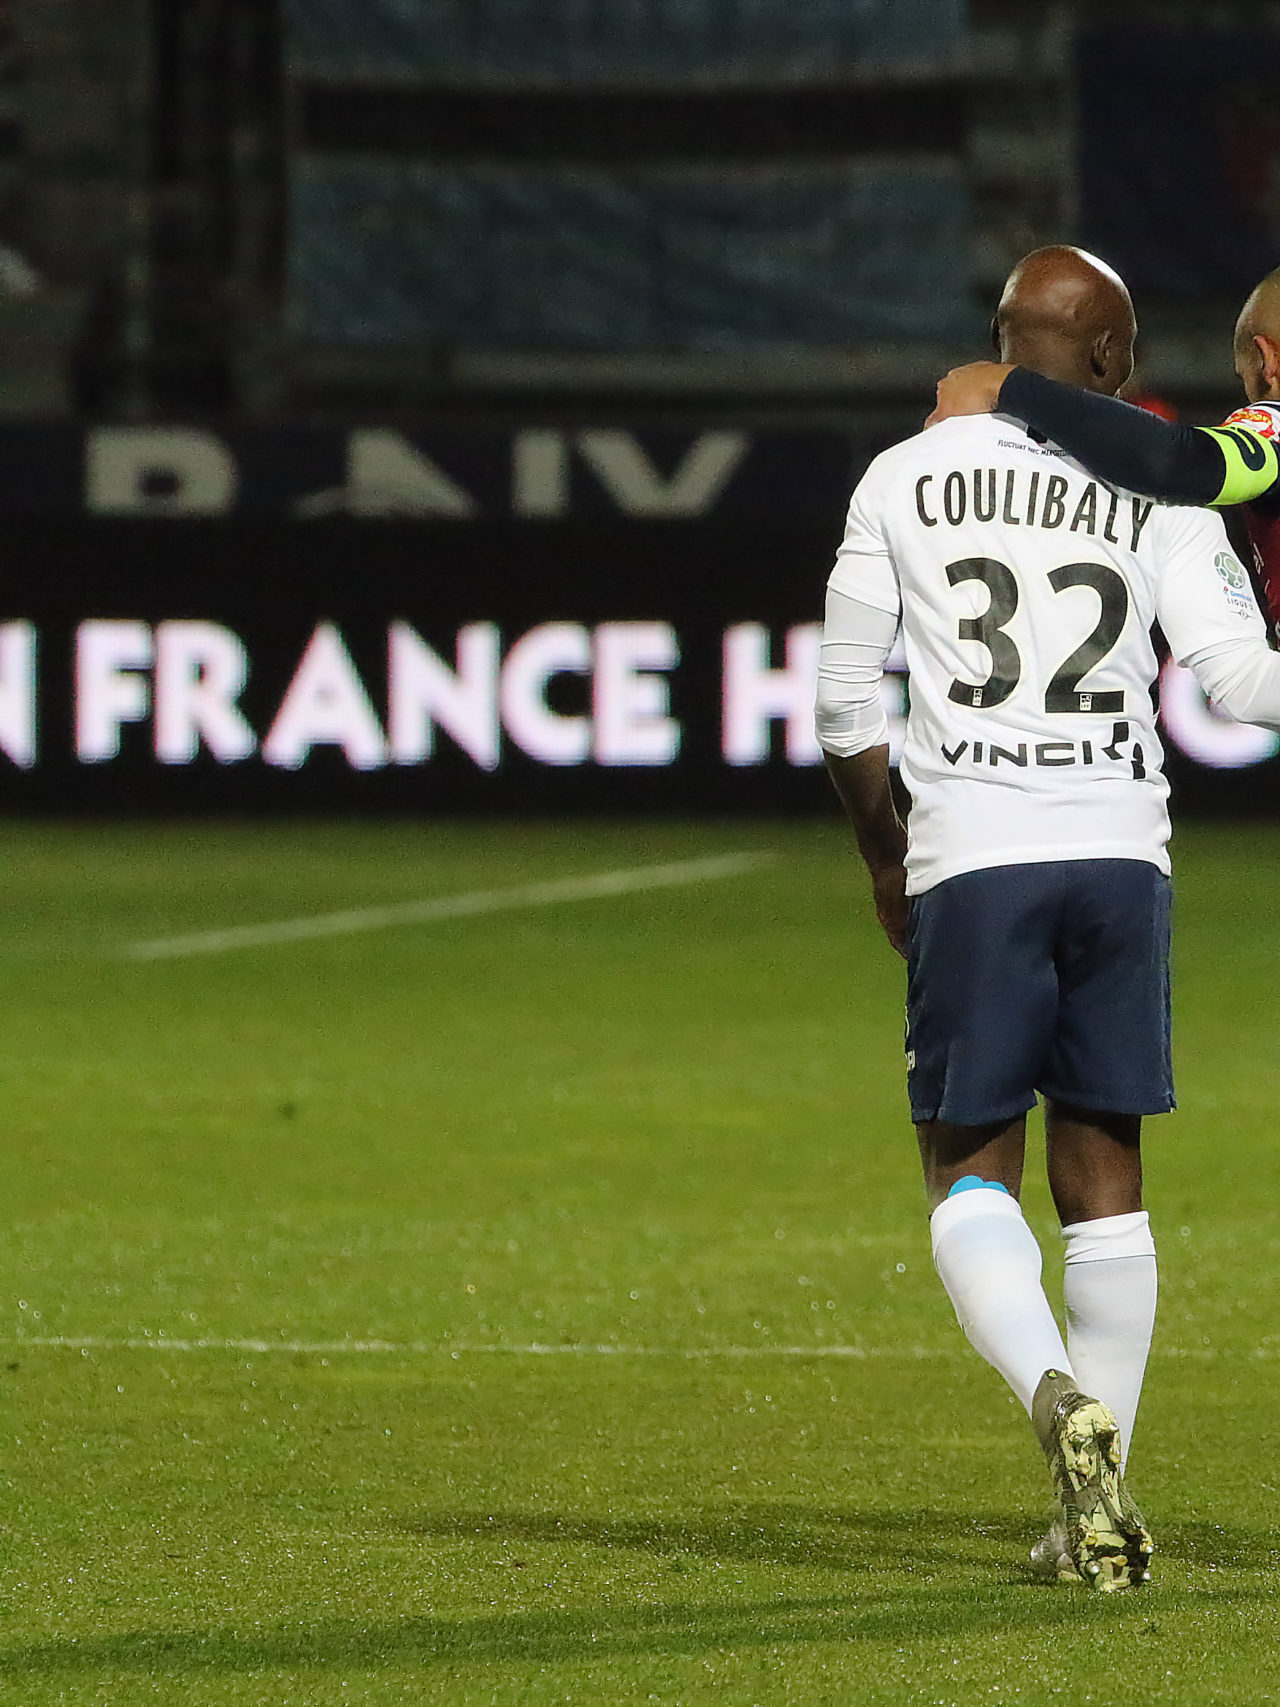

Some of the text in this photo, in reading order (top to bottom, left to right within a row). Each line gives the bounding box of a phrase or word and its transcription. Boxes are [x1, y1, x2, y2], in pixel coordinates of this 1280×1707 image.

[915, 468, 1154, 552] COULIBALY
[943, 556, 1129, 713] 32
[75, 619, 682, 771] FRANCE
[941, 741, 1092, 766] VINCI
